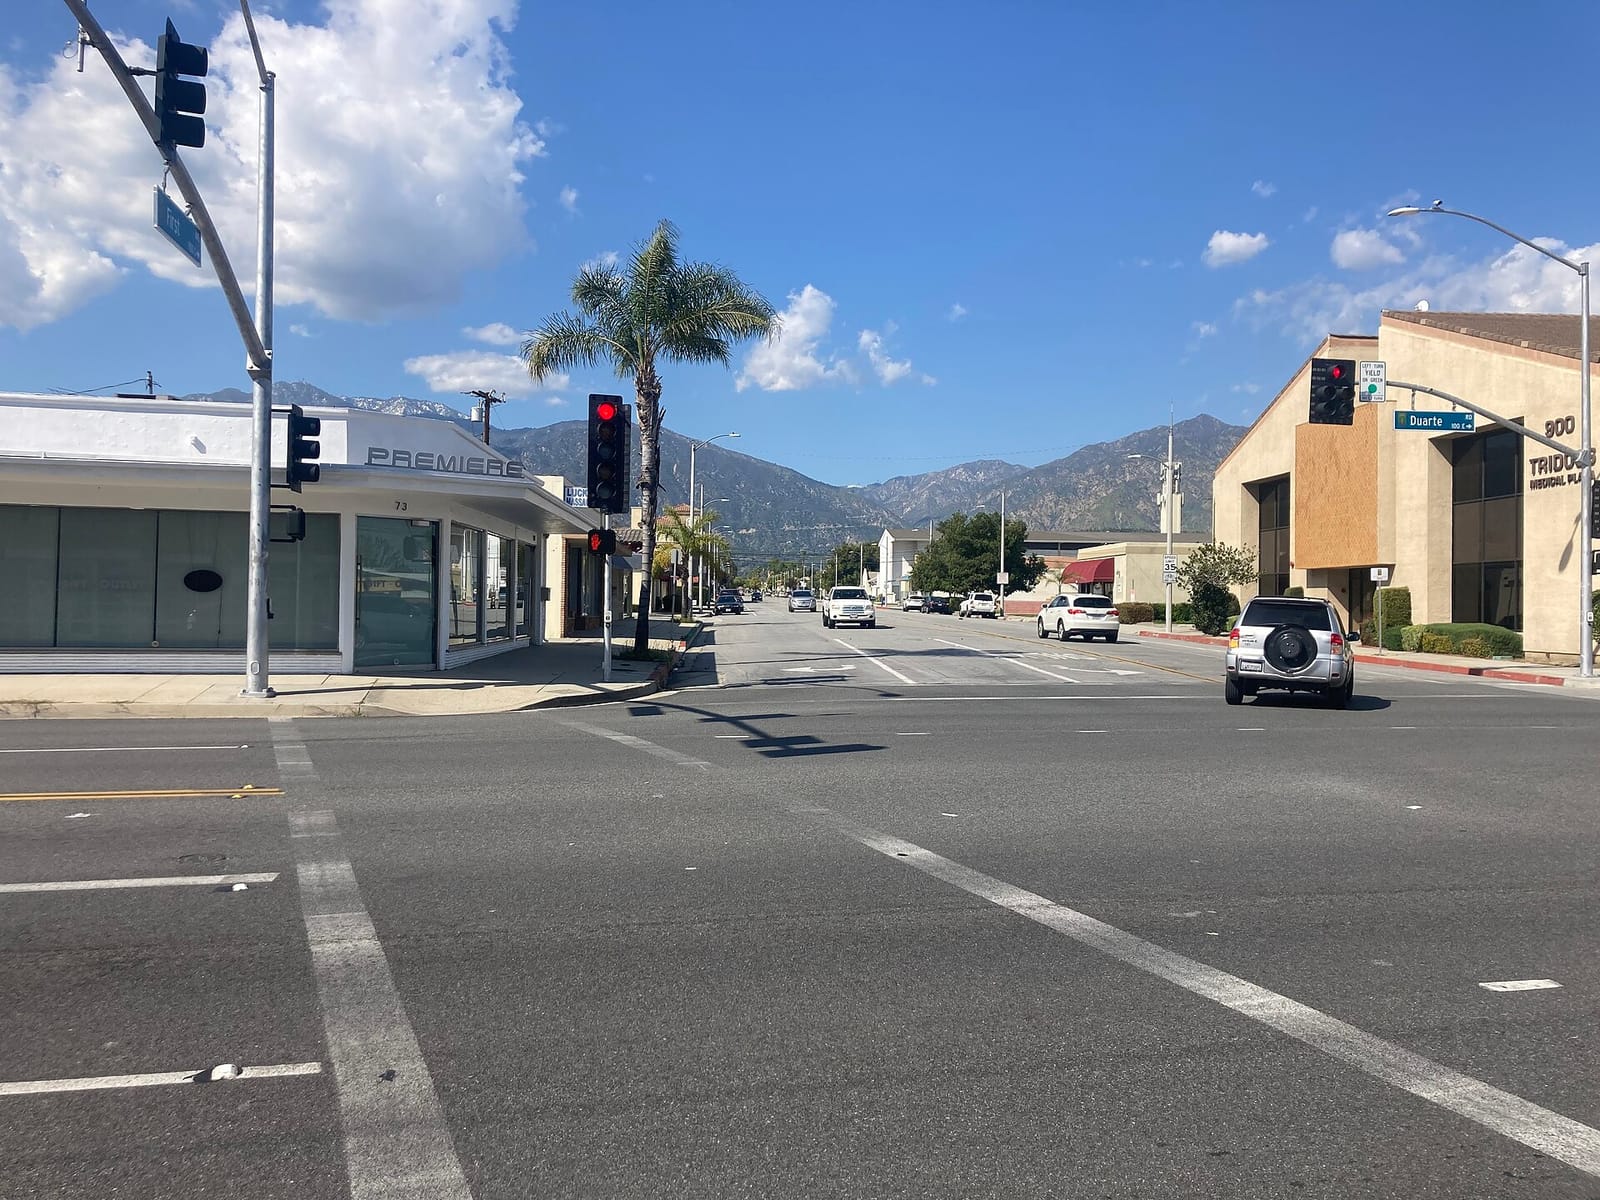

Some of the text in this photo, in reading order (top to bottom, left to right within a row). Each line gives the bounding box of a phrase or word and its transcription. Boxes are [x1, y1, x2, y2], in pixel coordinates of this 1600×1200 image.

[1410, 415, 1443, 426] Duarte
[1545, 416, 1575, 438] 900
[367, 447, 525, 478] PREMIERE
[1530, 475, 1566, 491] MEDICAL
[395, 502, 408, 511] 73
